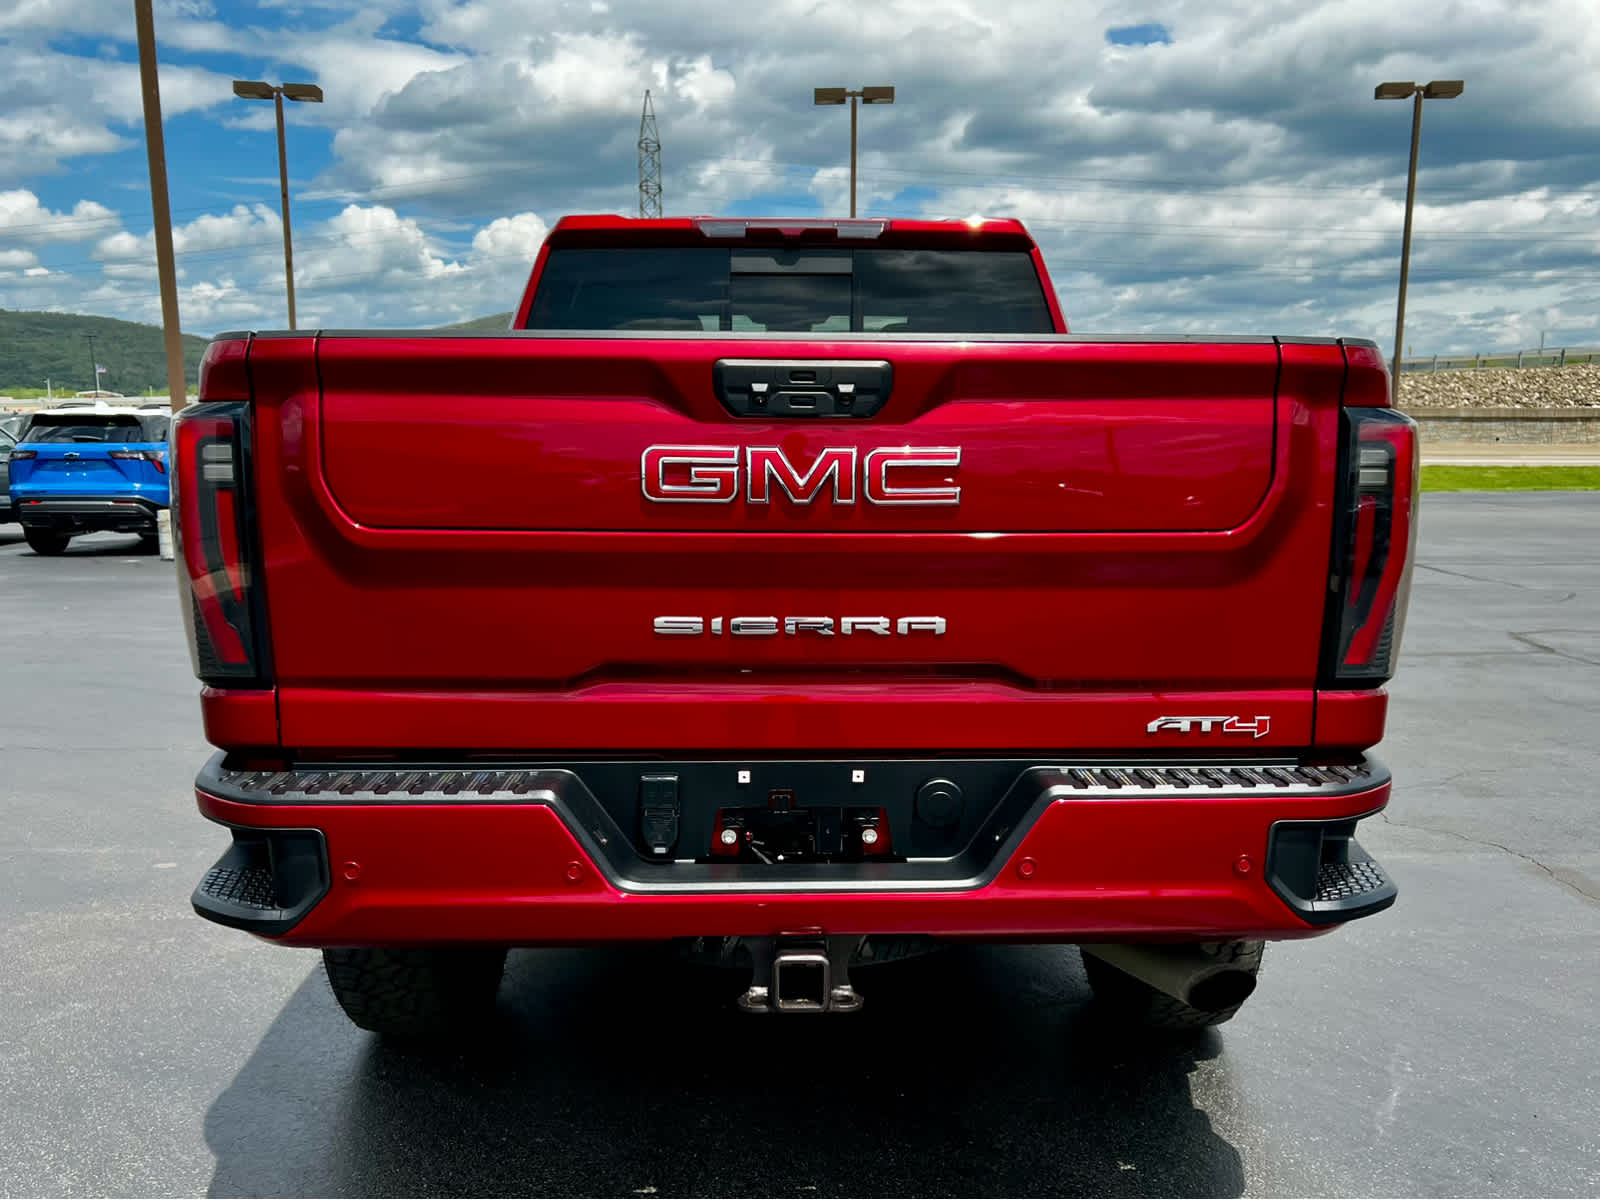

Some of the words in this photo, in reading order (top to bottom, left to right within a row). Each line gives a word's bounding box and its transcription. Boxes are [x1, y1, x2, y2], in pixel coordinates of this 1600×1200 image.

[641, 445, 962, 505] GMC
[653, 615, 947, 636] SIERRA
[1146, 715, 1271, 738] AT4
